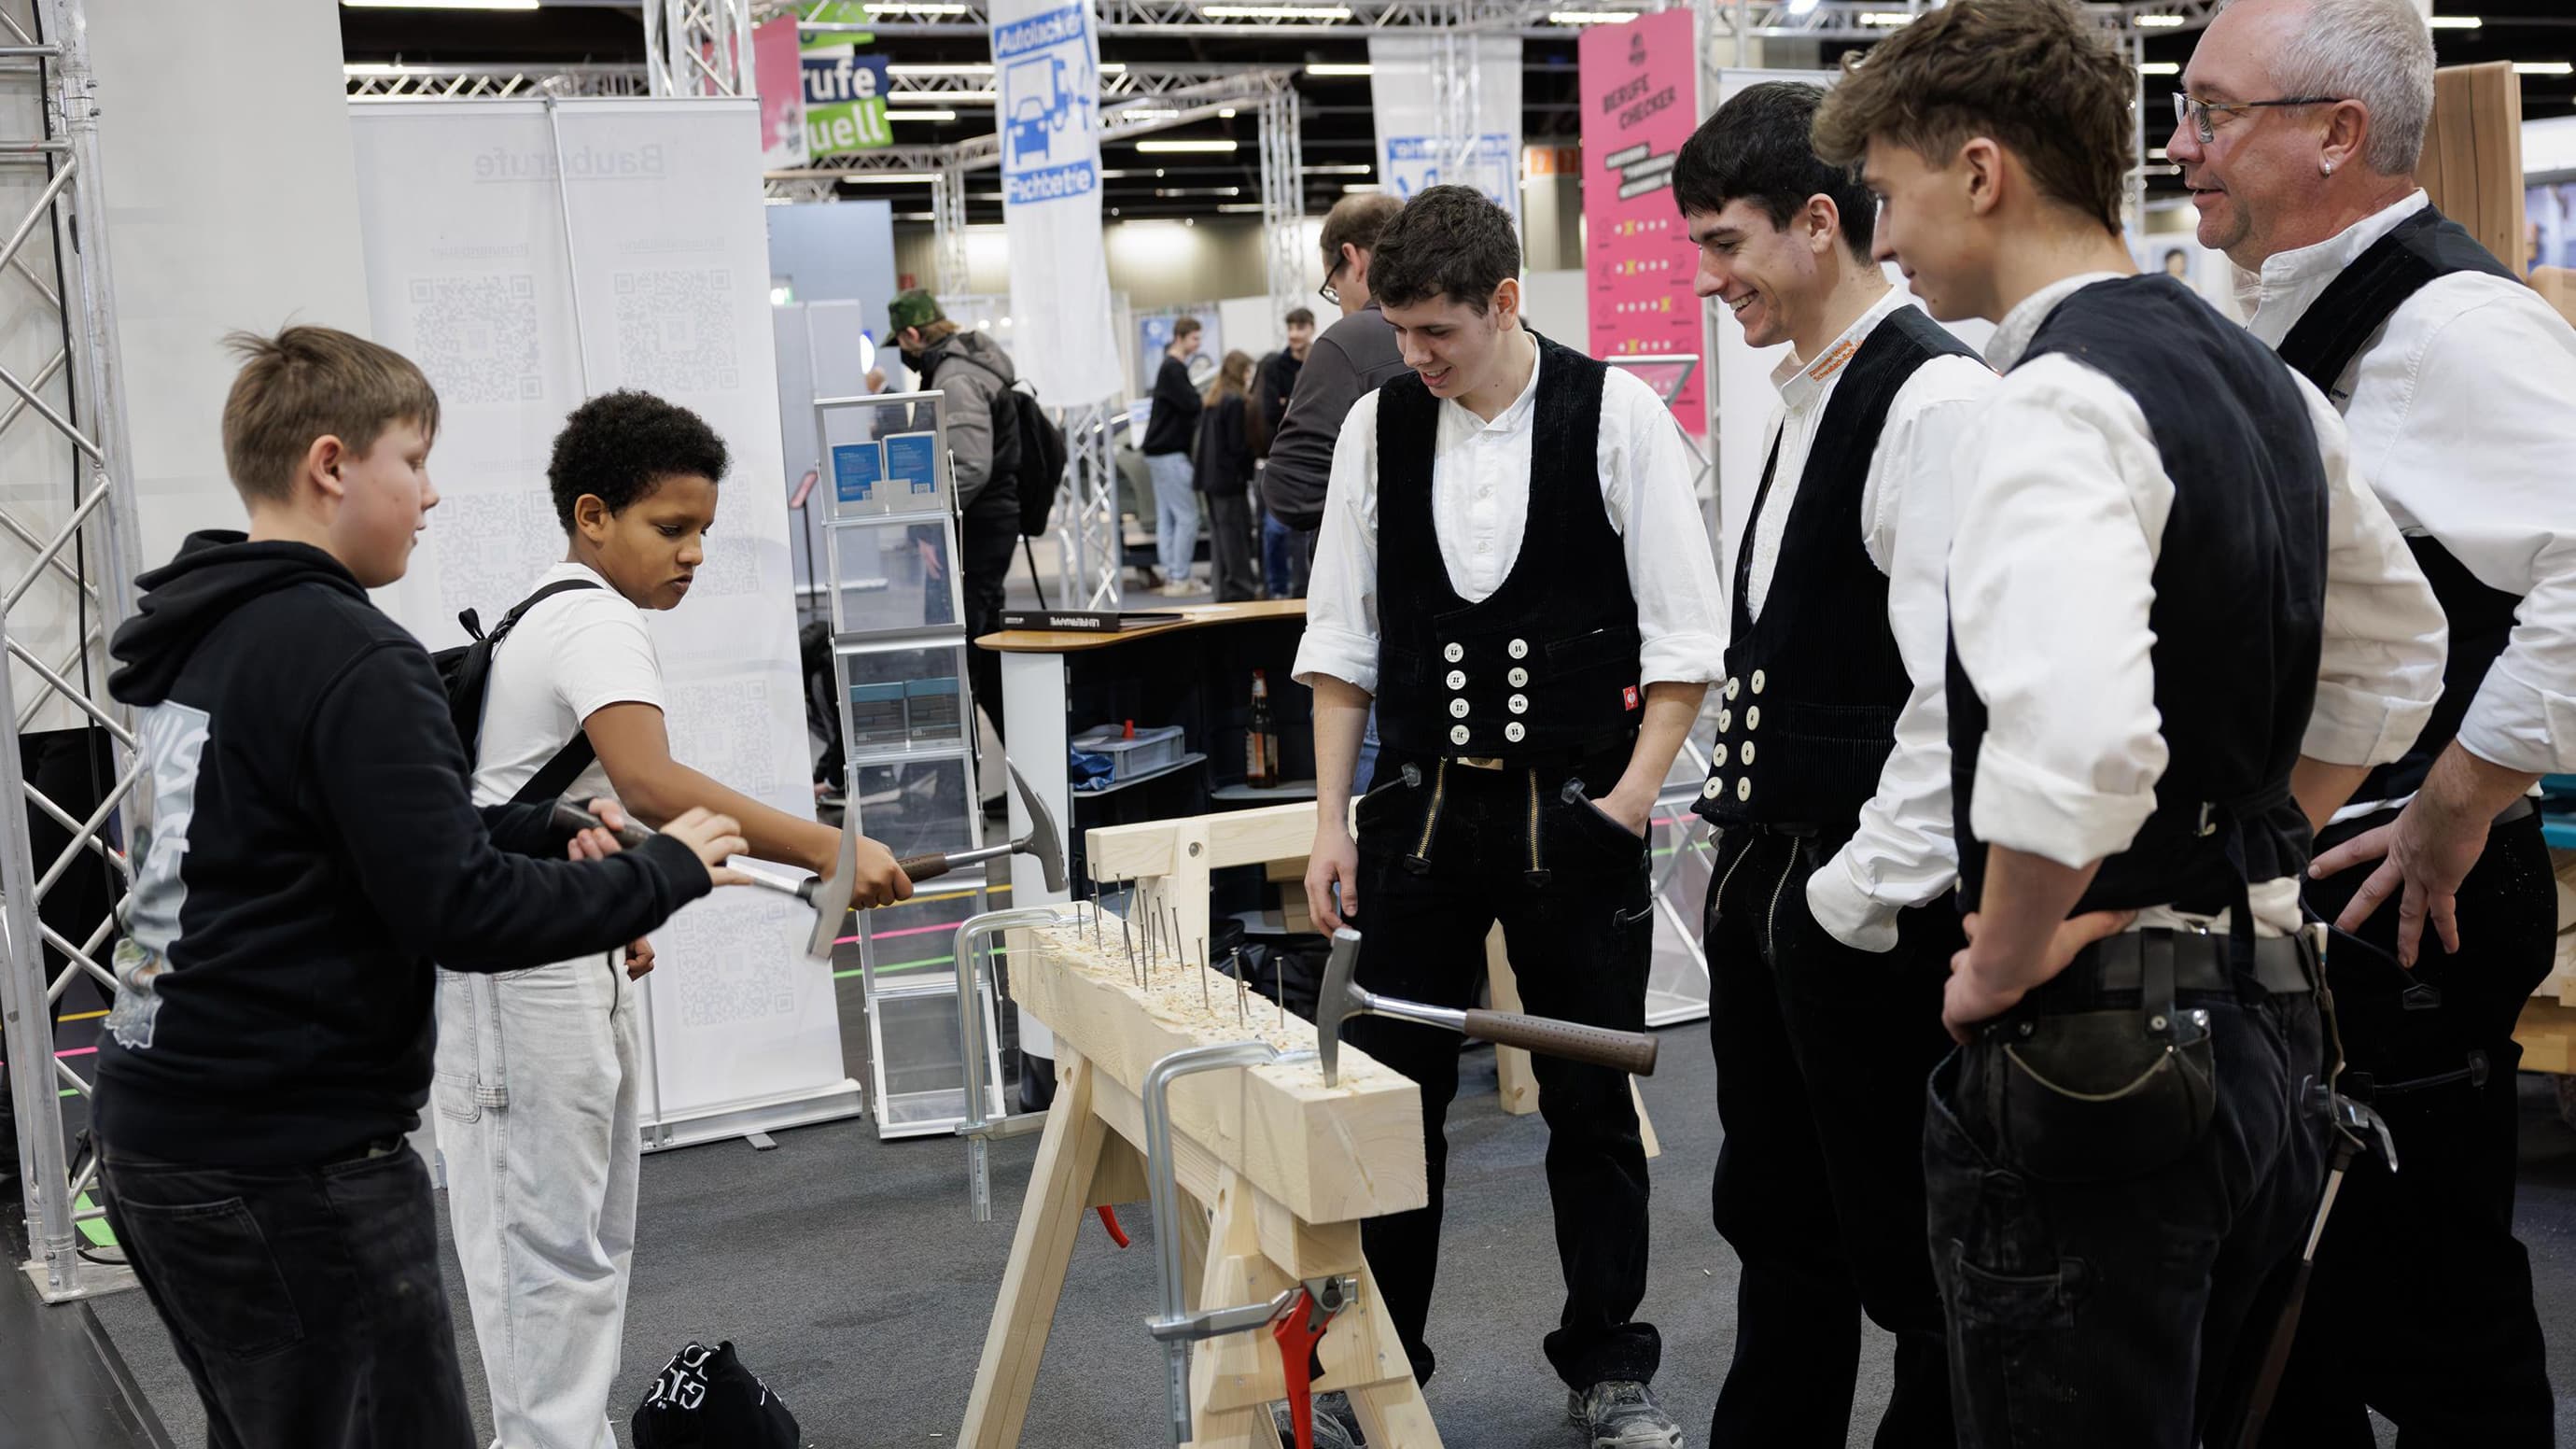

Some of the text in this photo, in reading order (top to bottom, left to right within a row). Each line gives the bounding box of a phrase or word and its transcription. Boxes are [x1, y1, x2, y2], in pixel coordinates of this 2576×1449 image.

[801, 58, 877, 101] rufe
[807, 102, 885, 153] uell
[1618, 86, 1677, 130] CHECKER
